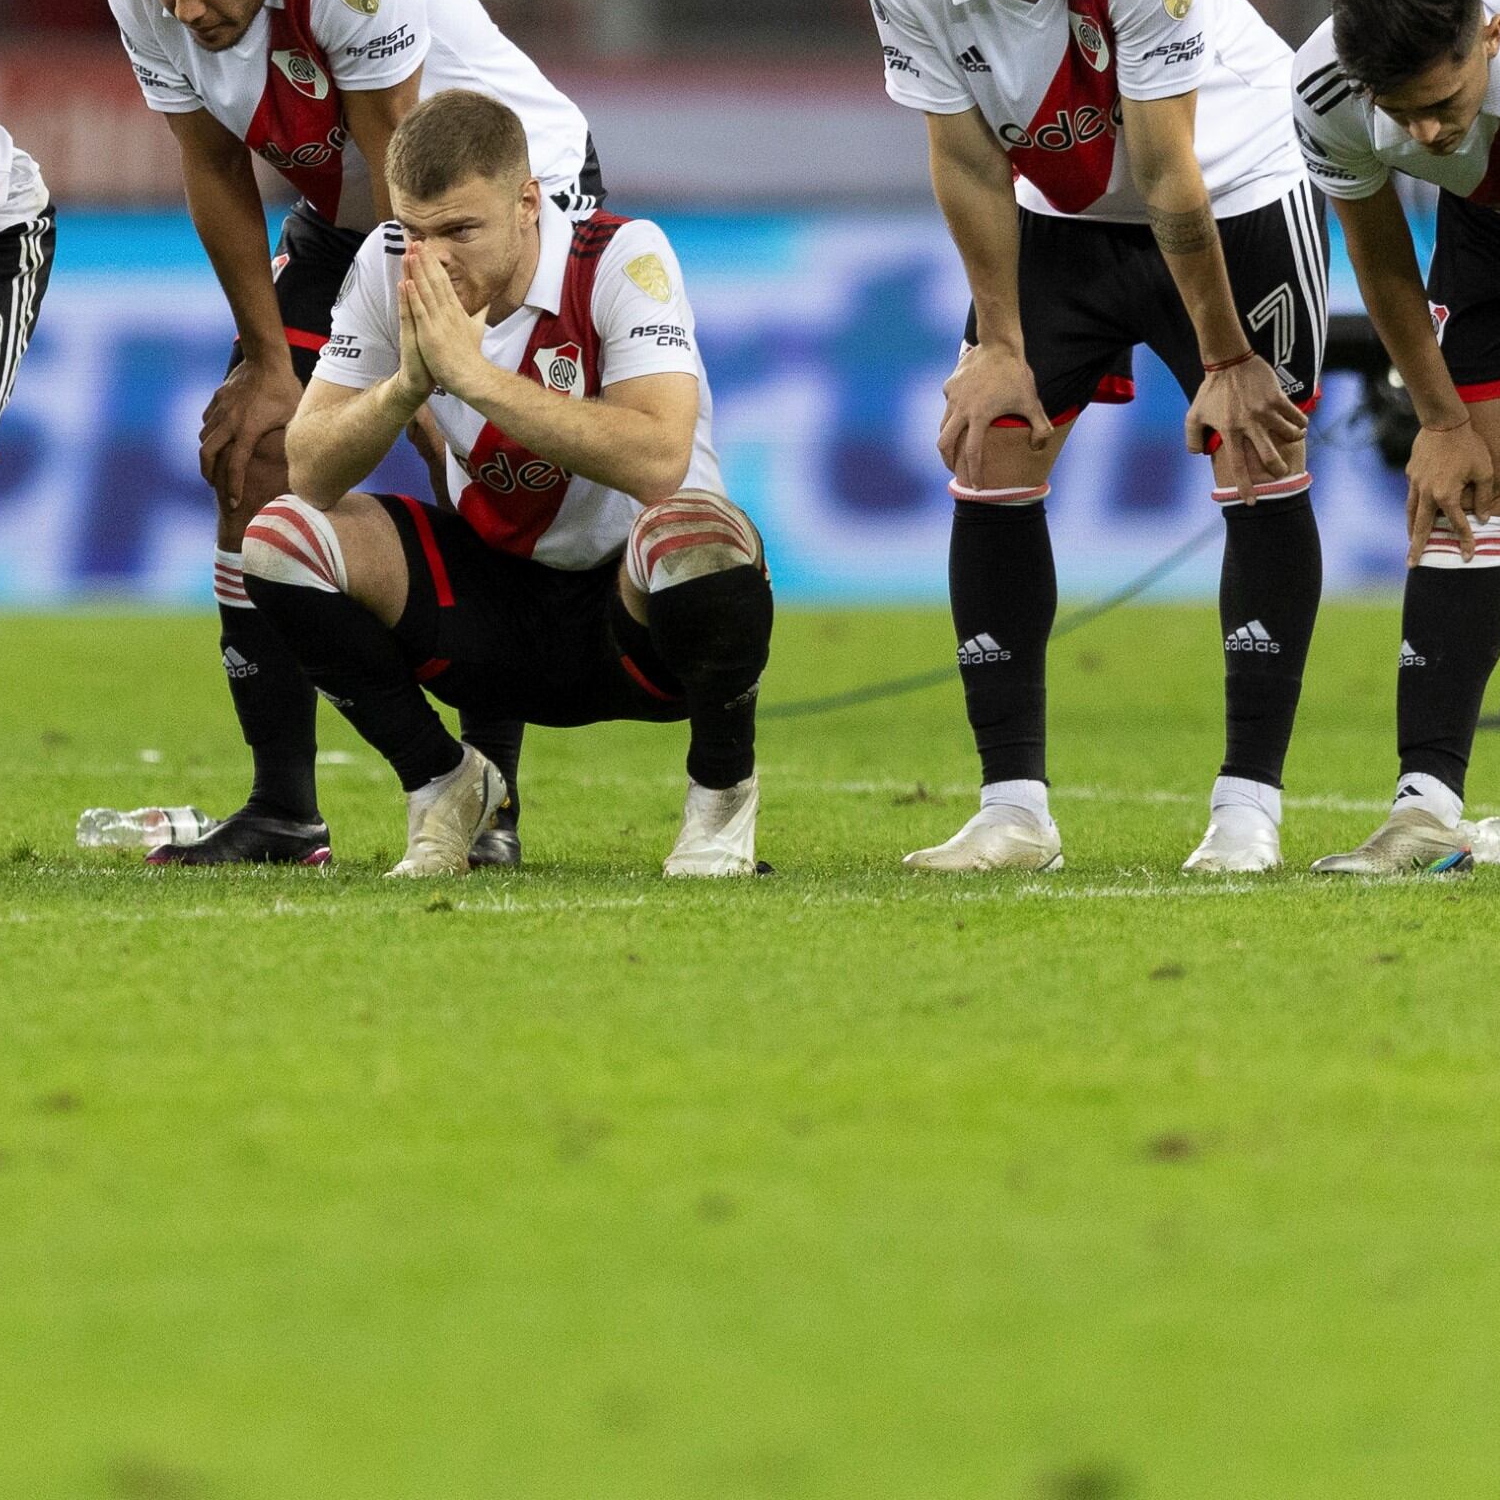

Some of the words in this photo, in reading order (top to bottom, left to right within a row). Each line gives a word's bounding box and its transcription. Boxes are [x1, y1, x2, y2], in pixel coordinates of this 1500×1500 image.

[346, 23, 408, 57] ASSIST
[367, 34, 415, 60] CARD
[1142, 31, 1203, 60] ASSIST
[998, 105, 1124, 152] ode
[629, 324, 687, 339] ASSIST
[1246, 282, 1296, 368] 7
[549, 356, 578, 390] CARP
[1282, 380, 1305, 396] das
[1224, 639, 1280, 654] adidas
